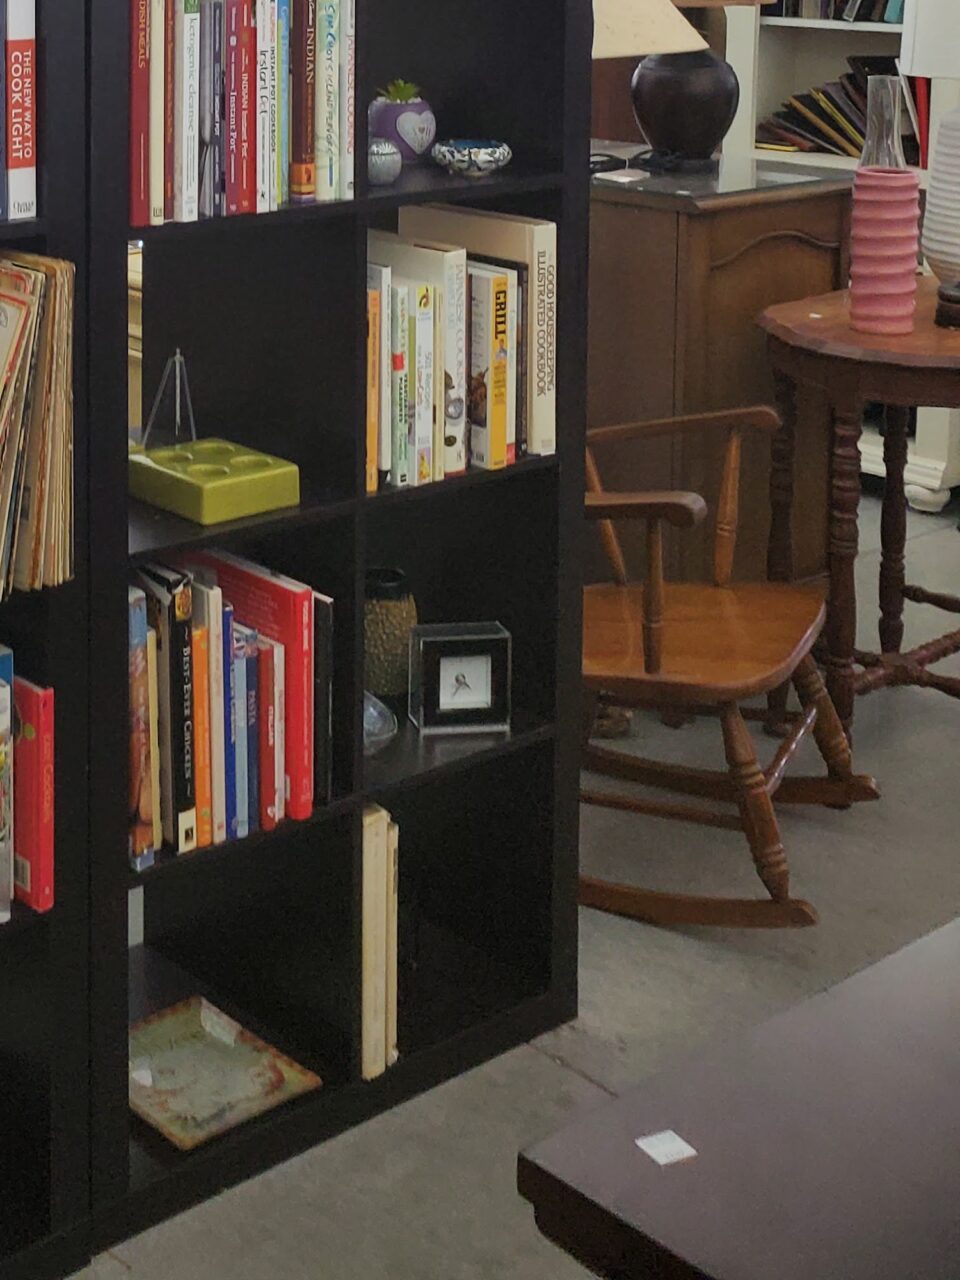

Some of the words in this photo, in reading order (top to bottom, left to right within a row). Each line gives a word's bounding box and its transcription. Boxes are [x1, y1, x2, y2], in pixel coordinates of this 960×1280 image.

[23, 49, 32, 74] THE
[138, 32, 146, 68] MEALS
[187, 17, 198, 80] ketogenic
[306, 28, 314, 84] INDIAN
[11, 51, 22, 103] COOK
[23, 79, 32, 108] NEW
[12, 108, 22, 159] LIGHT
[24, 110, 32, 138] WAY
[188, 84, 198, 133] cleanse
[24, 141, 32, 158] TO
[537, 251, 546, 326] ILLUSTRATED
[495, 290, 506, 340] GRILL
[537, 330, 546, 397] COOKBOOK
[546, 301, 554, 391] HOUSEKEEPING
[182, 647, 192, 717] BEST-EVER
[248, 691, 256, 726] PASTA
[183, 721, 193, 779] CHICKEN
